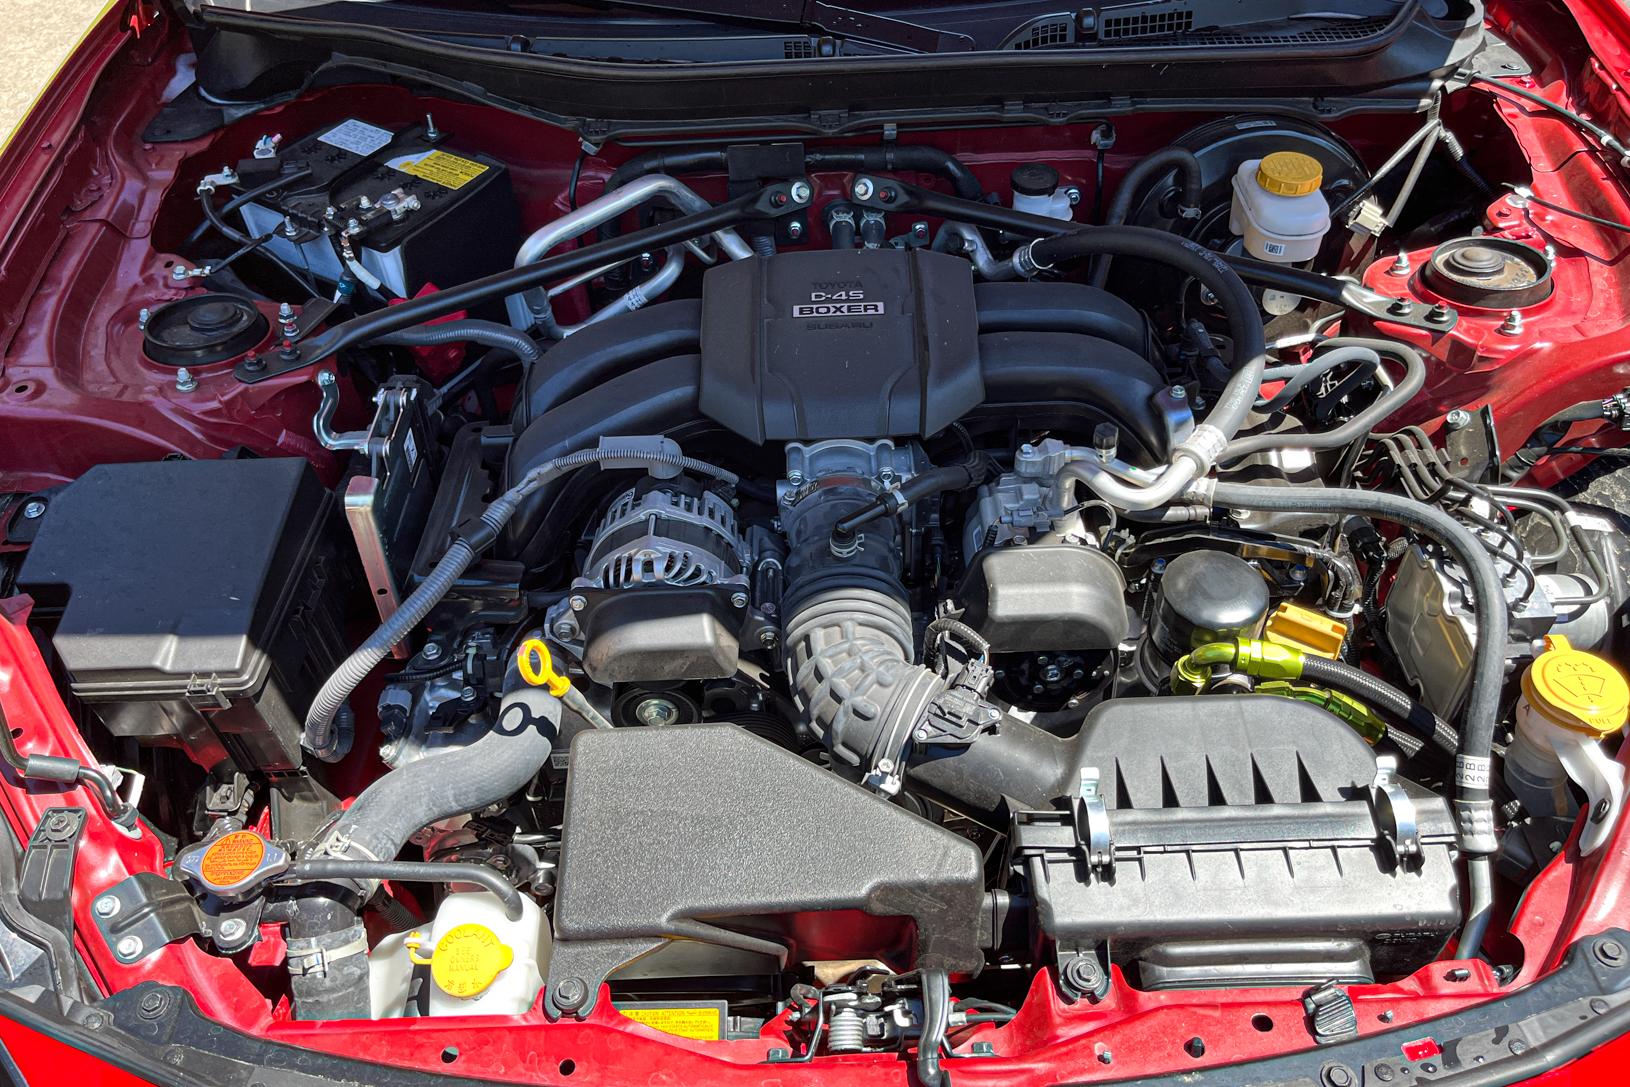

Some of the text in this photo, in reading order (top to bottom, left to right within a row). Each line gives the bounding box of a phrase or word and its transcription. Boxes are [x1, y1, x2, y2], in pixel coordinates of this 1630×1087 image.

[811, 281, 863, 289] TOYOTA
[811, 290, 864, 301] D-4S
[798, 304, 879, 316] BOXER
[807, 322, 874, 331] SUBARU
[438, 927, 496, 952] COOLANT
